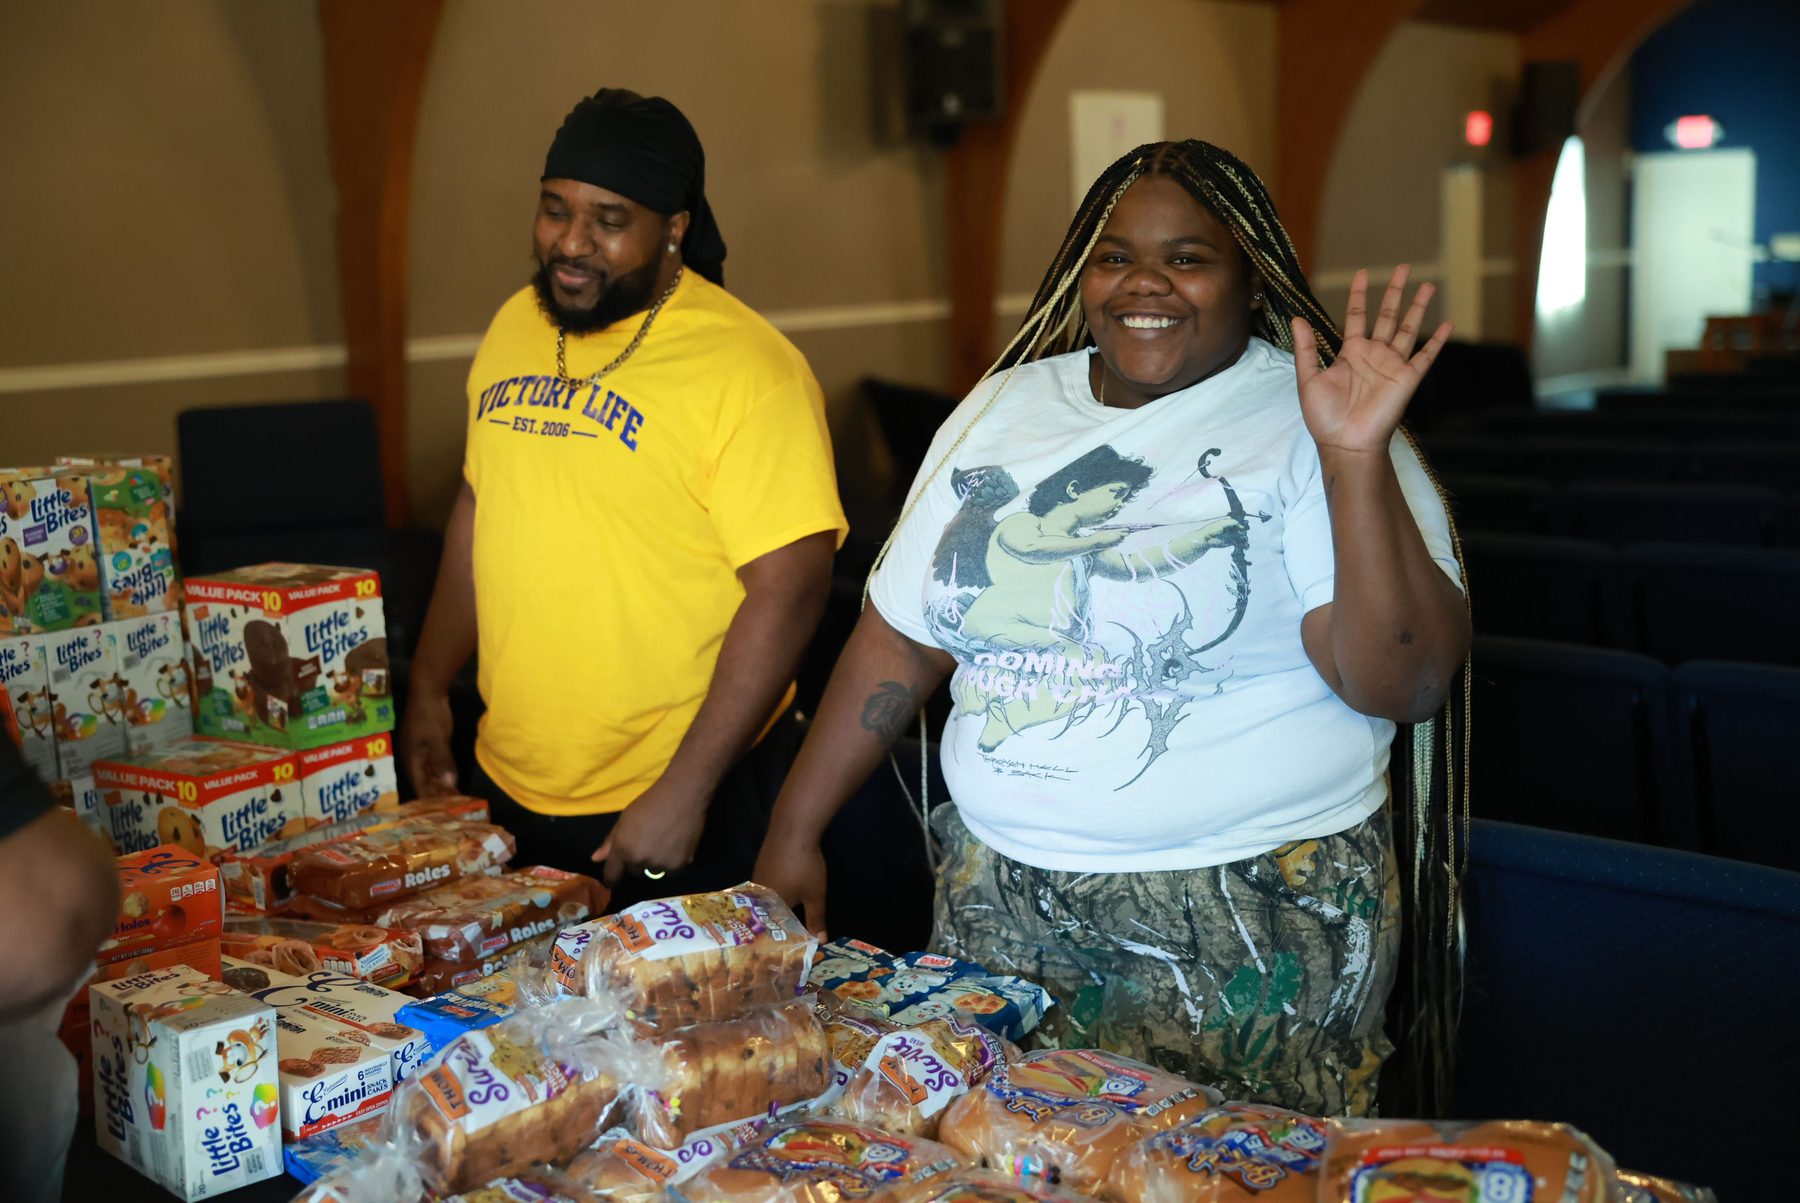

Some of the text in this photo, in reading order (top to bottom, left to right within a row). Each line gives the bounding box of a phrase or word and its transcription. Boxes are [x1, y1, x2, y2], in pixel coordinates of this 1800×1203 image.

[477, 376, 644, 452] VICTORY LIFE
[512, 417, 570, 437] EST. 2006
[31, 488, 71, 523] Little
[46, 505, 88, 534] Bites
[186, 585, 281, 612] VALUE PACK 10
[288, 578, 376, 600] VALUE PACK 10
[127, 622, 157, 651] Little
[138, 634, 169, 659] Bites
[199, 613, 229, 654] Little
[305, 611, 349, 653] Little
[322, 625, 368, 665] Bites
[57, 636, 88, 665] Little
[69, 648, 102, 673] Bites
[211, 642, 245, 673] Bites
[304, 738, 387, 764] VALUE PACK 10
[96, 769, 198, 801] VALUE PACK 10
[204, 762, 294, 791] VALUE PACK 10
[319, 770, 360, 814] Little
[335, 785, 380, 823] Bites
[109, 801, 143, 841] Little
[221, 796, 267, 843] Little
[239, 812, 287, 851] Bites
[122, 829, 159, 854] Bites
[405, 863, 451, 889] Roles
[510, 918, 556, 943] Roles
[111, 973, 156, 991] Little
[136, 972, 181, 990] Bites
[310, 1001, 355, 1016] mini
[358, 1070, 364, 1081] 6
[367, 1078, 388, 1089] SNACK
[367, 1084, 389, 1096] CAKES
[327, 1082, 367, 1111] mini
[366, 1104, 376, 1113] OPEN
[222, 1102, 254, 1154] Bites
[201, 1125, 241, 1177] Little
